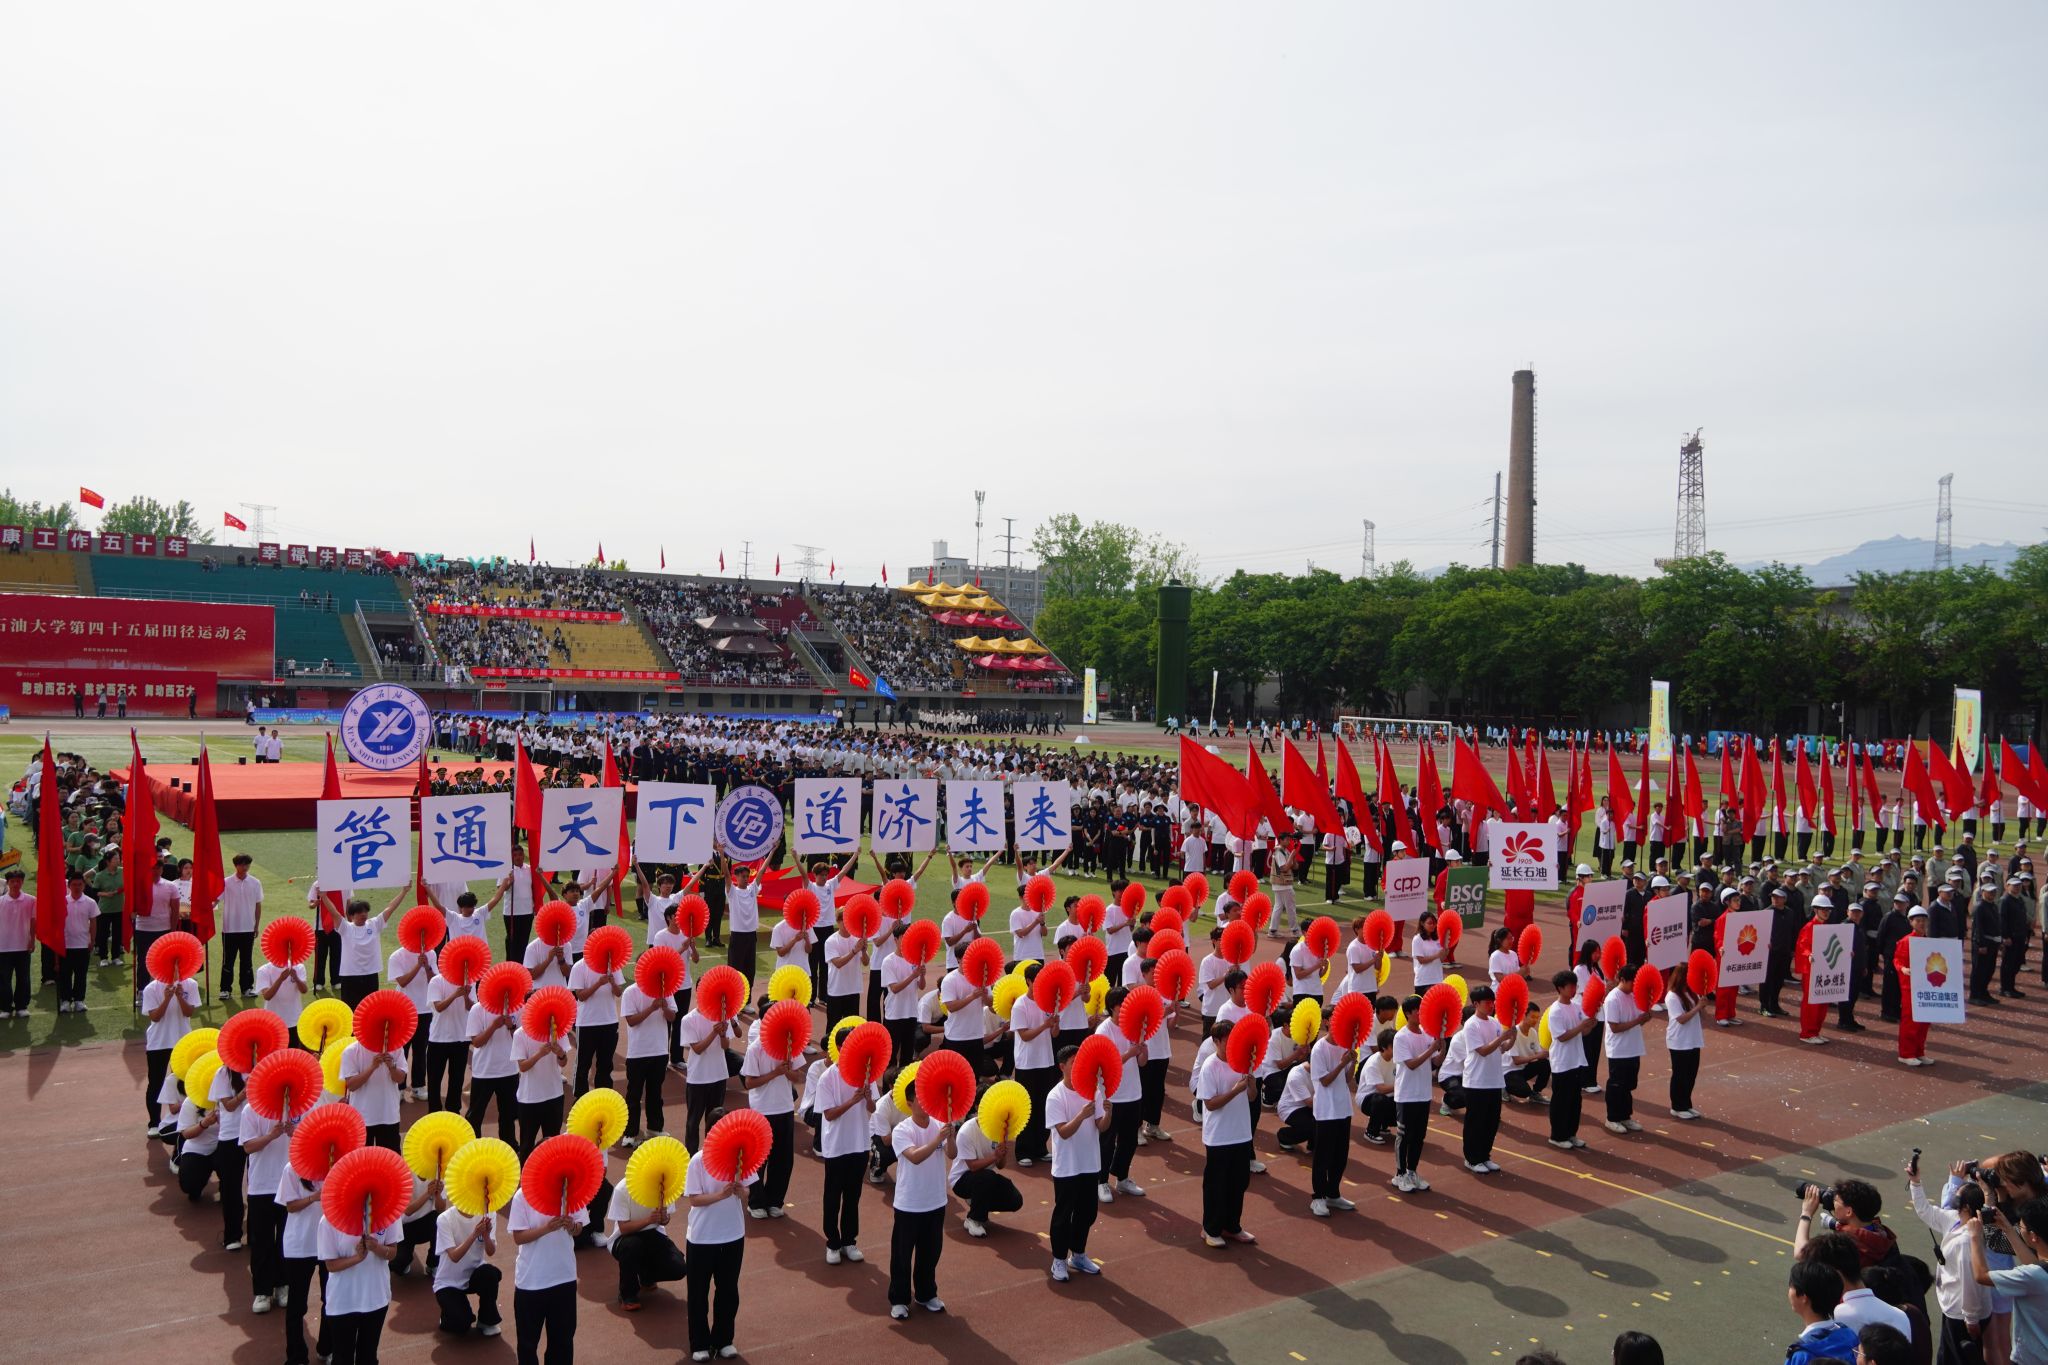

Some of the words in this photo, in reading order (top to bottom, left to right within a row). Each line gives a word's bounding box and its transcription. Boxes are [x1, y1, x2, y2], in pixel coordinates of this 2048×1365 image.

[2, 528, 185, 555] 康工作五十年
[262, 544, 363, 566] 幸福生活
[22, 681, 77, 697] 跑动西石大
[1500, 866, 1548, 878] 延长石油
[1450, 884, 1484, 902] BSG
[1917, 991, 1958, 1002] 中国石油集团
